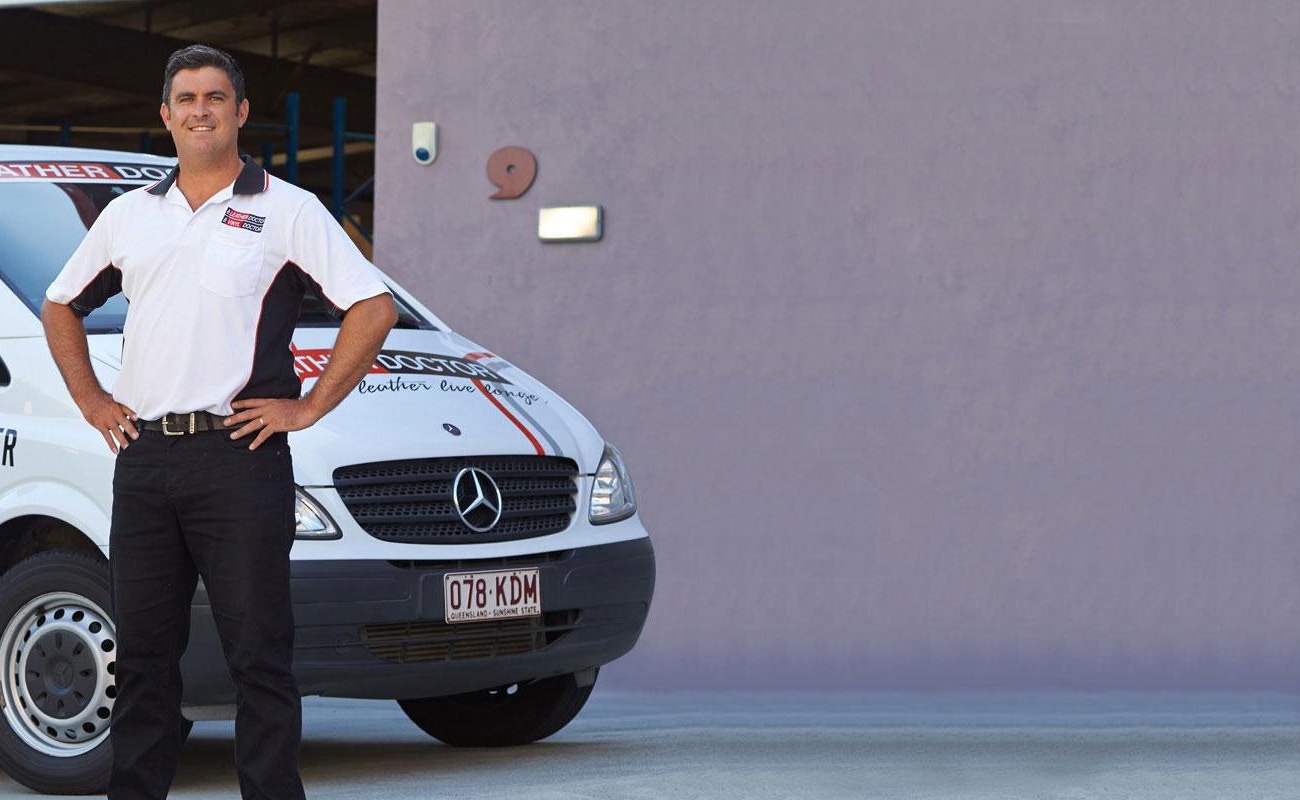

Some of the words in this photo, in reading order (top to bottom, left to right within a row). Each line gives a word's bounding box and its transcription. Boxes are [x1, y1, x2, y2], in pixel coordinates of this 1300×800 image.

[487, 146, 538, 200] 9
[377, 354, 499, 379] DOCTOR
[358, 376, 432, 394] leather
[484, 384, 542, 405] longe
[451, 610, 488, 619] QUEENSLAND
[493, 608, 518, 617] SUNSHINE
